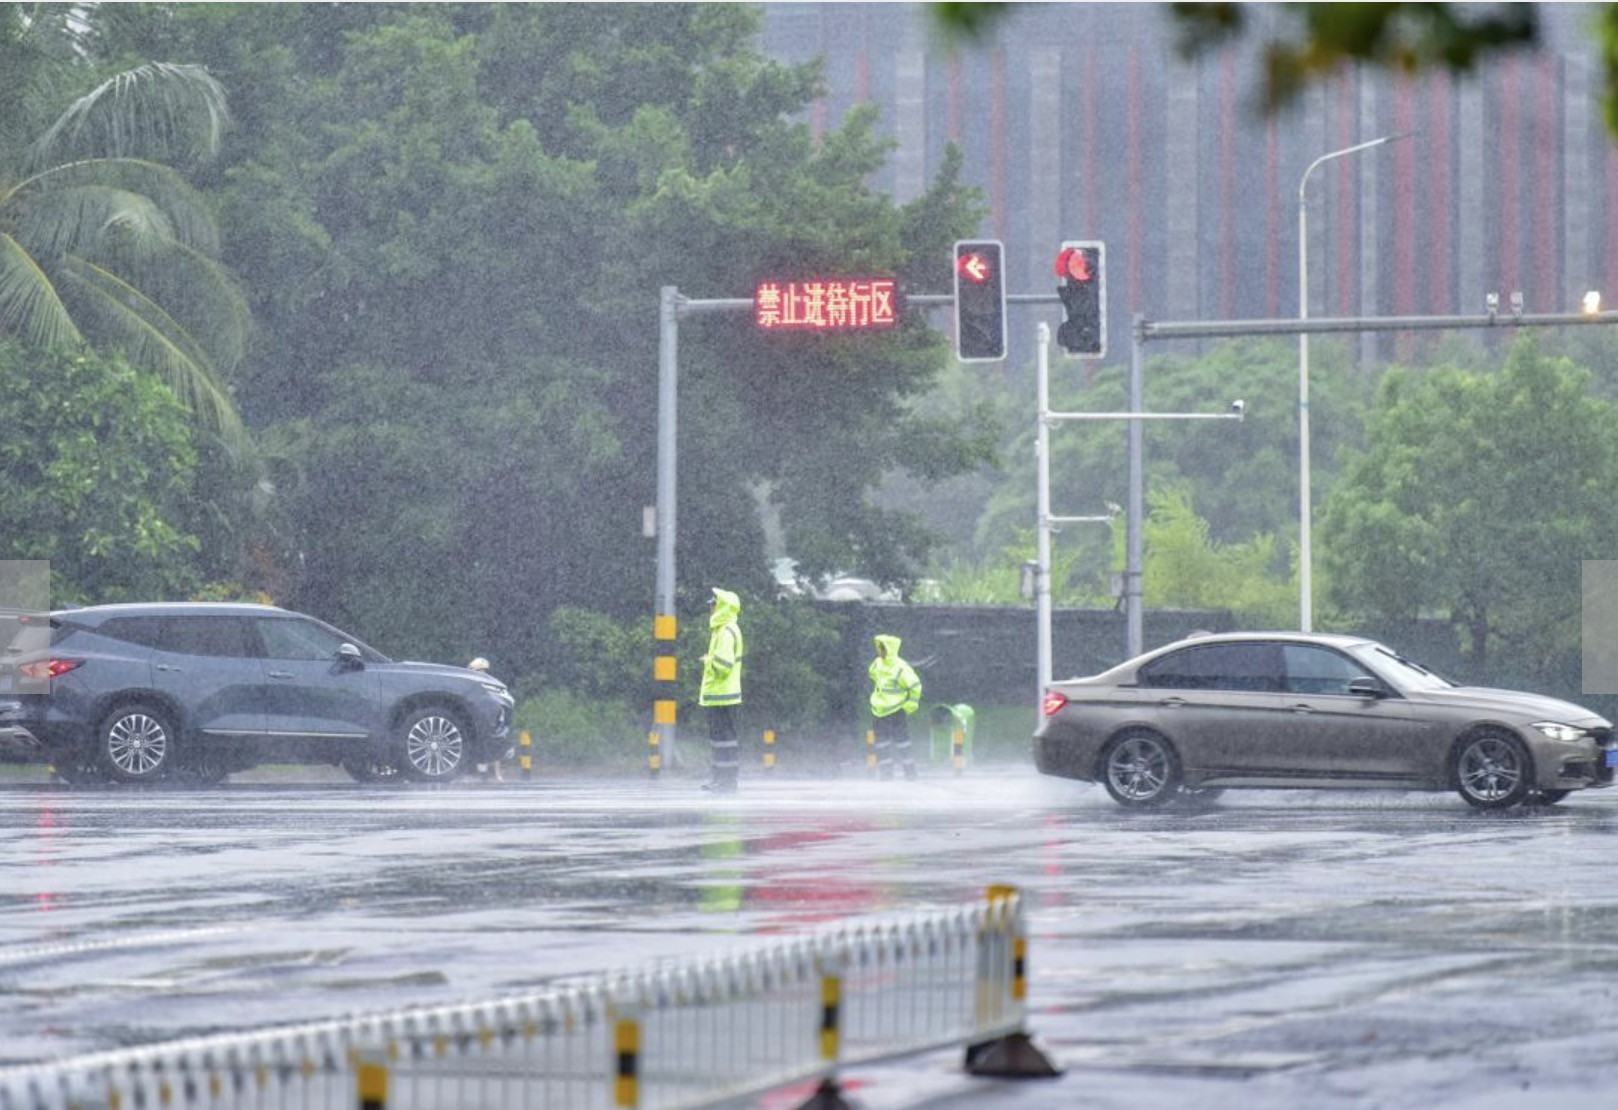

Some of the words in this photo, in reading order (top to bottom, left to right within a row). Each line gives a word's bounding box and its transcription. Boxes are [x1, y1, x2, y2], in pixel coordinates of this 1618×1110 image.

[757, 281, 894, 326] 禁止进待行区
